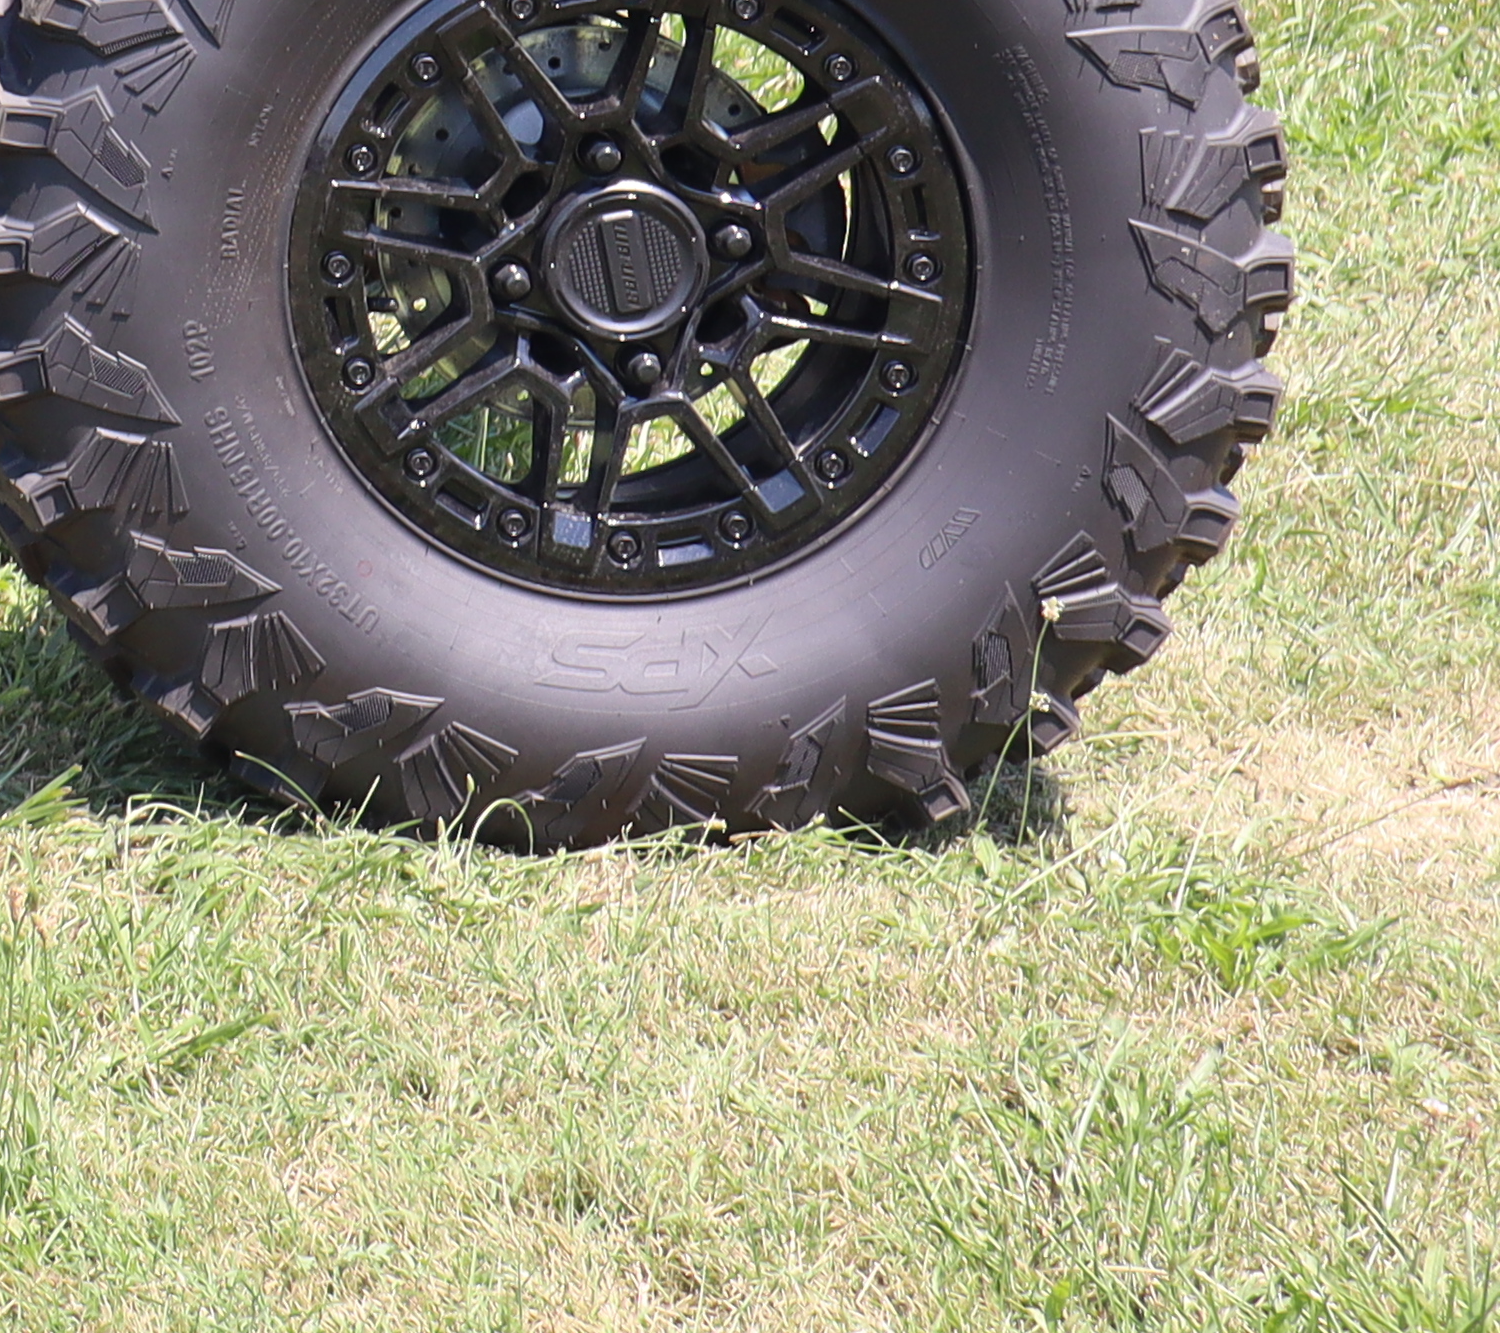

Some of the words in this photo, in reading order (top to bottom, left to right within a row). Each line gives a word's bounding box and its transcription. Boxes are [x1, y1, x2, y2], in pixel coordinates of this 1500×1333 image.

[219, 183, 246, 259] RADIAL
[182, 320, 212, 382] 102P
[534, 610, 779, 711] XPS
